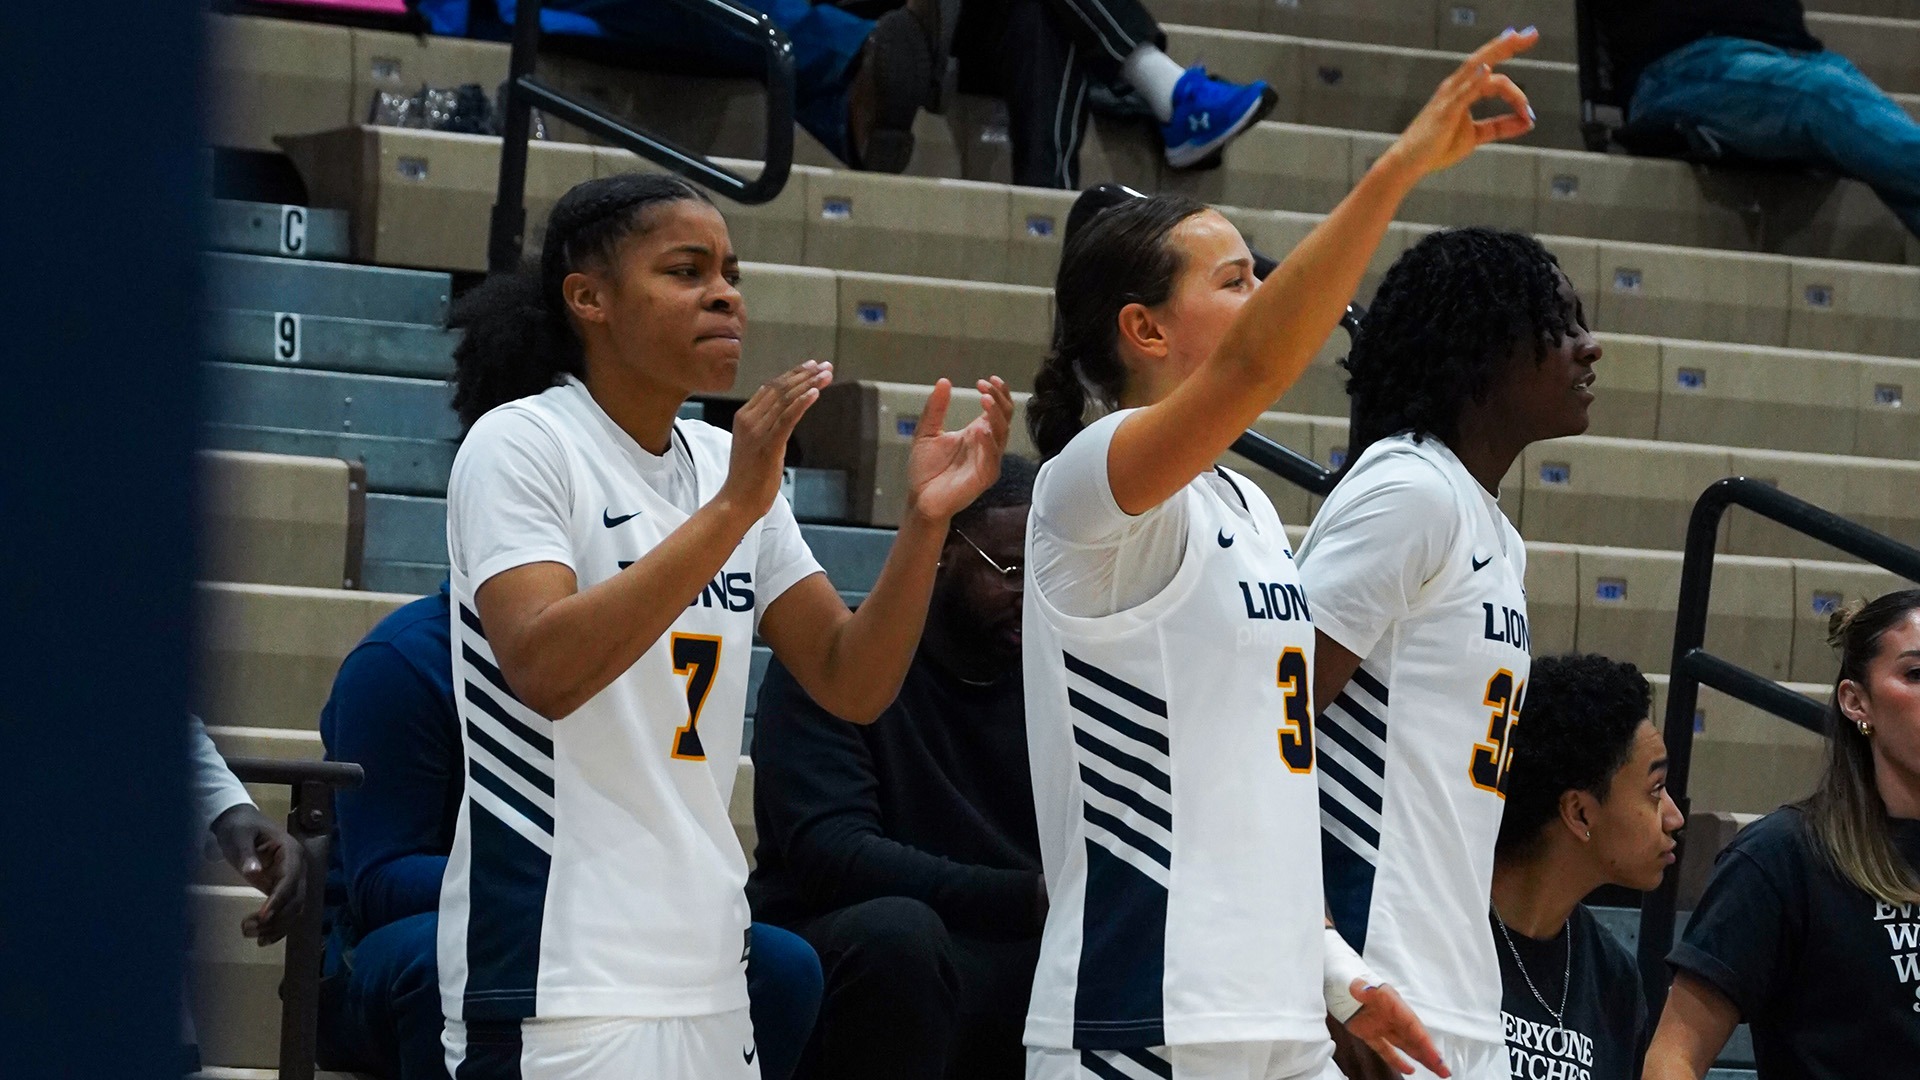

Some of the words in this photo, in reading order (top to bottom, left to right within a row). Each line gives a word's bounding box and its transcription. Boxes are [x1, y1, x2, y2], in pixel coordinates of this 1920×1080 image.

[286, 210, 302, 251] C
[280, 315, 295, 358] 9
[671, 631, 722, 761] 7
[1277, 647, 1314, 774] 3
